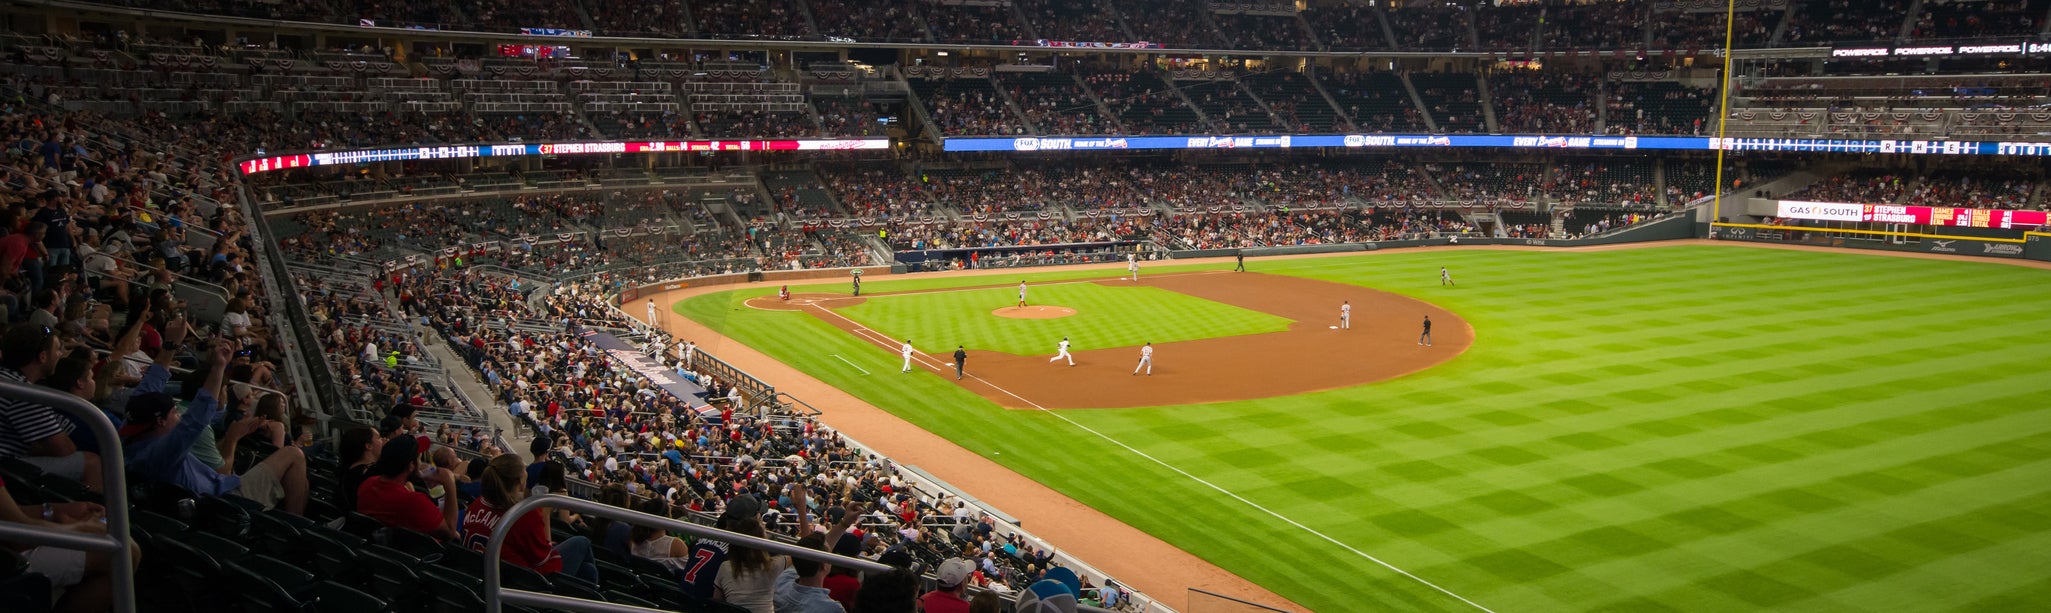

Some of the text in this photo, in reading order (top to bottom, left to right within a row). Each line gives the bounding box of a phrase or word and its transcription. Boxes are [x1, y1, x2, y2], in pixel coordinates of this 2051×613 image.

[543, 144, 553, 154] 37
[553, 143, 585, 154] STEPHEN
[584, 142, 626, 153] STRASBURG
[1187, 137, 1209, 147] EVERY
[1234, 137, 1253, 147] GAME
[1513, 136, 1538, 147] EVERY
[1567, 137, 1591, 148] GAME
[1789, 206, 1859, 218] GAS SOUTH
[1864, 205, 1907, 215] 37 STEPHEN
[1873, 213, 1916, 223] STRASBURG
[463, 509, 502, 531] McCAN
[684, 548, 715, 584] 7
